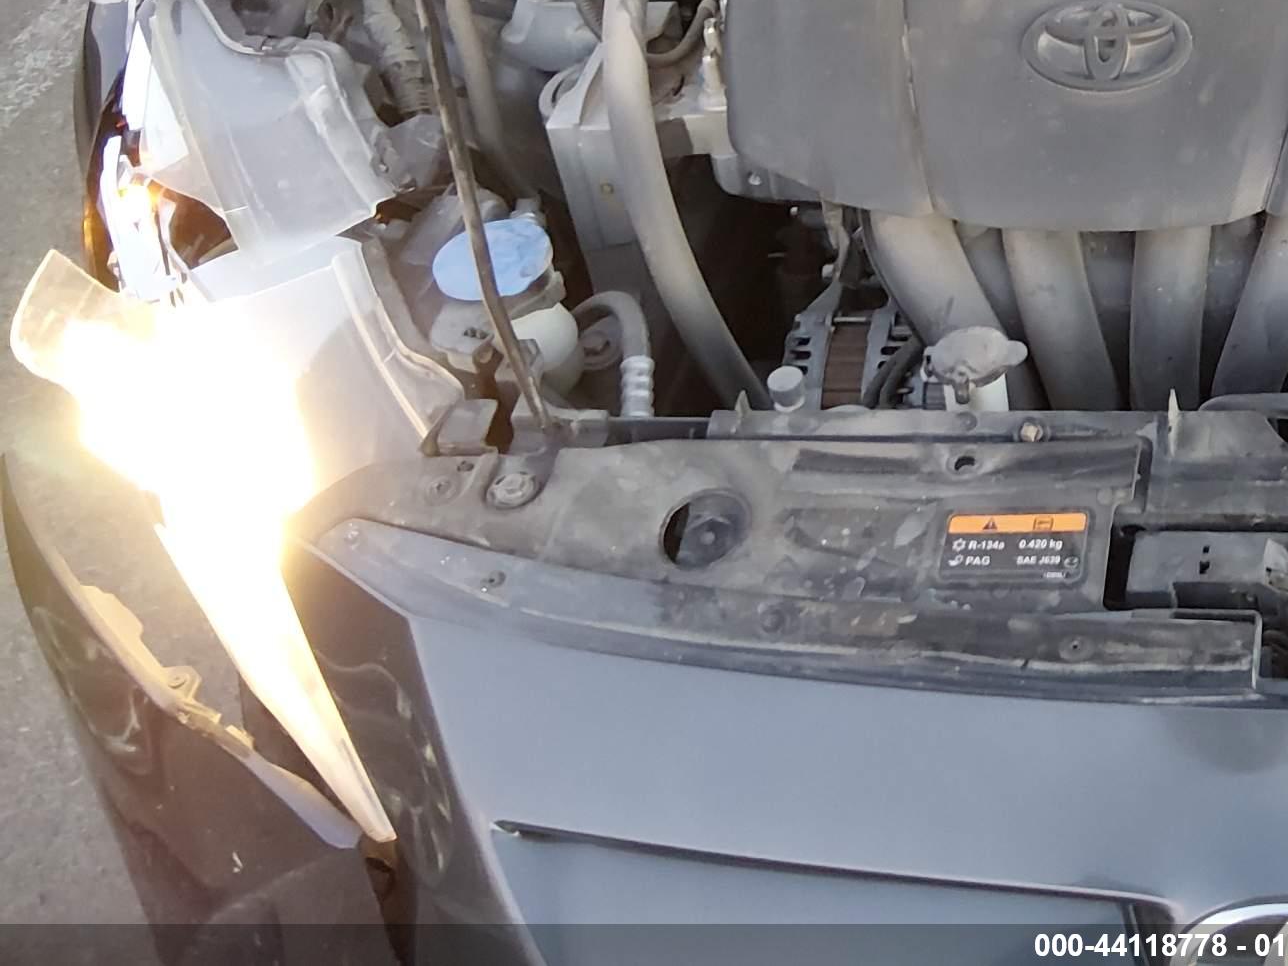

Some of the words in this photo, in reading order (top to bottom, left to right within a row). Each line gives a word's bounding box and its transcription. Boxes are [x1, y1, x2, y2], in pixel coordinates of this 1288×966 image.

[967, 539, 1005, 551] R-134a
[1049, 539, 1063, 551] kg
[965, 555, 991, 566] PAG
[1016, 555, 1036, 565] SAE
